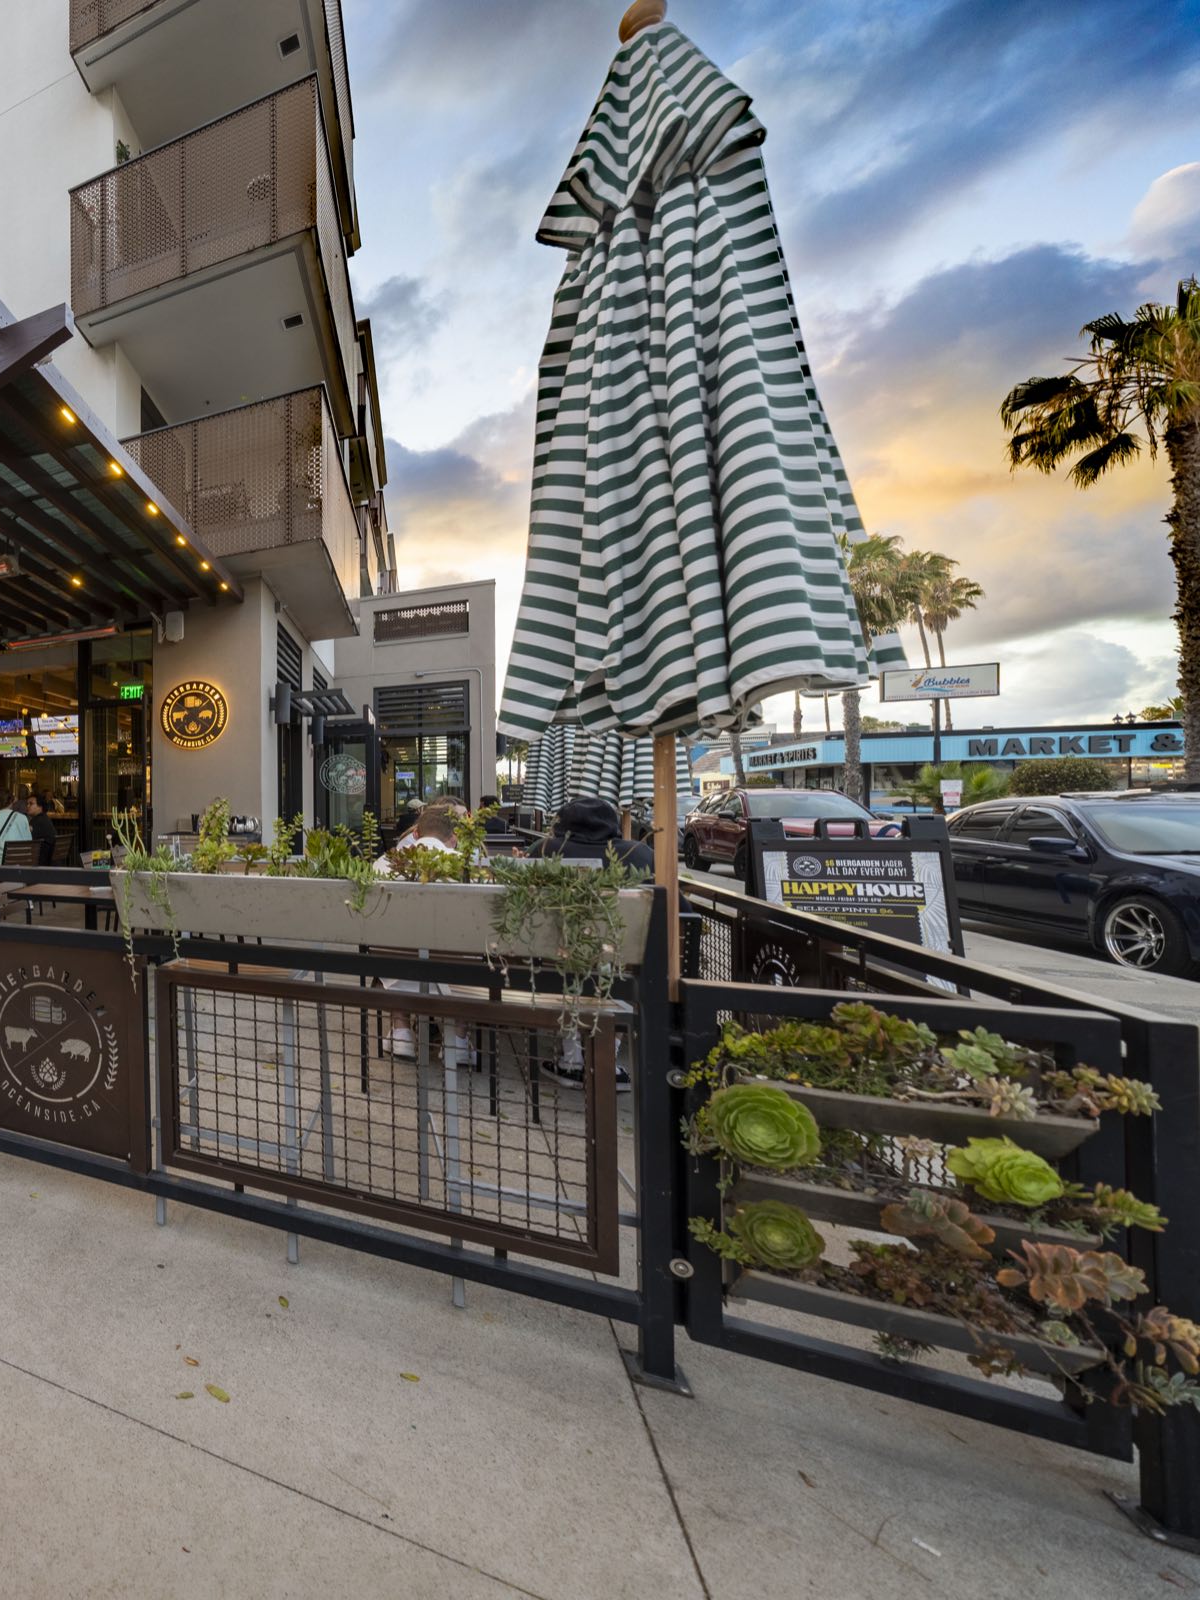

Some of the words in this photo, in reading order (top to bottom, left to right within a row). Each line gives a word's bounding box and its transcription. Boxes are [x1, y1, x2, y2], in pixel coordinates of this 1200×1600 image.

[924, 677, 970, 687] Bubbles
[125, 685, 141, 699] EXIT
[968, 734, 1136, 758] MARKET
[1150, 733, 1183, 753] &
[784, 748, 817, 763] SPIRITS
[835, 859, 880, 868] BIERGARDEN
[881, 860, 903, 868] LAGER
[826, 867, 840, 876] ALL
[843, 868, 857, 877] DAY
[860, 868, 884, 877] EVERY
[888, 868, 907, 877] DAY!
[841, 906, 878, 914] PINTS
